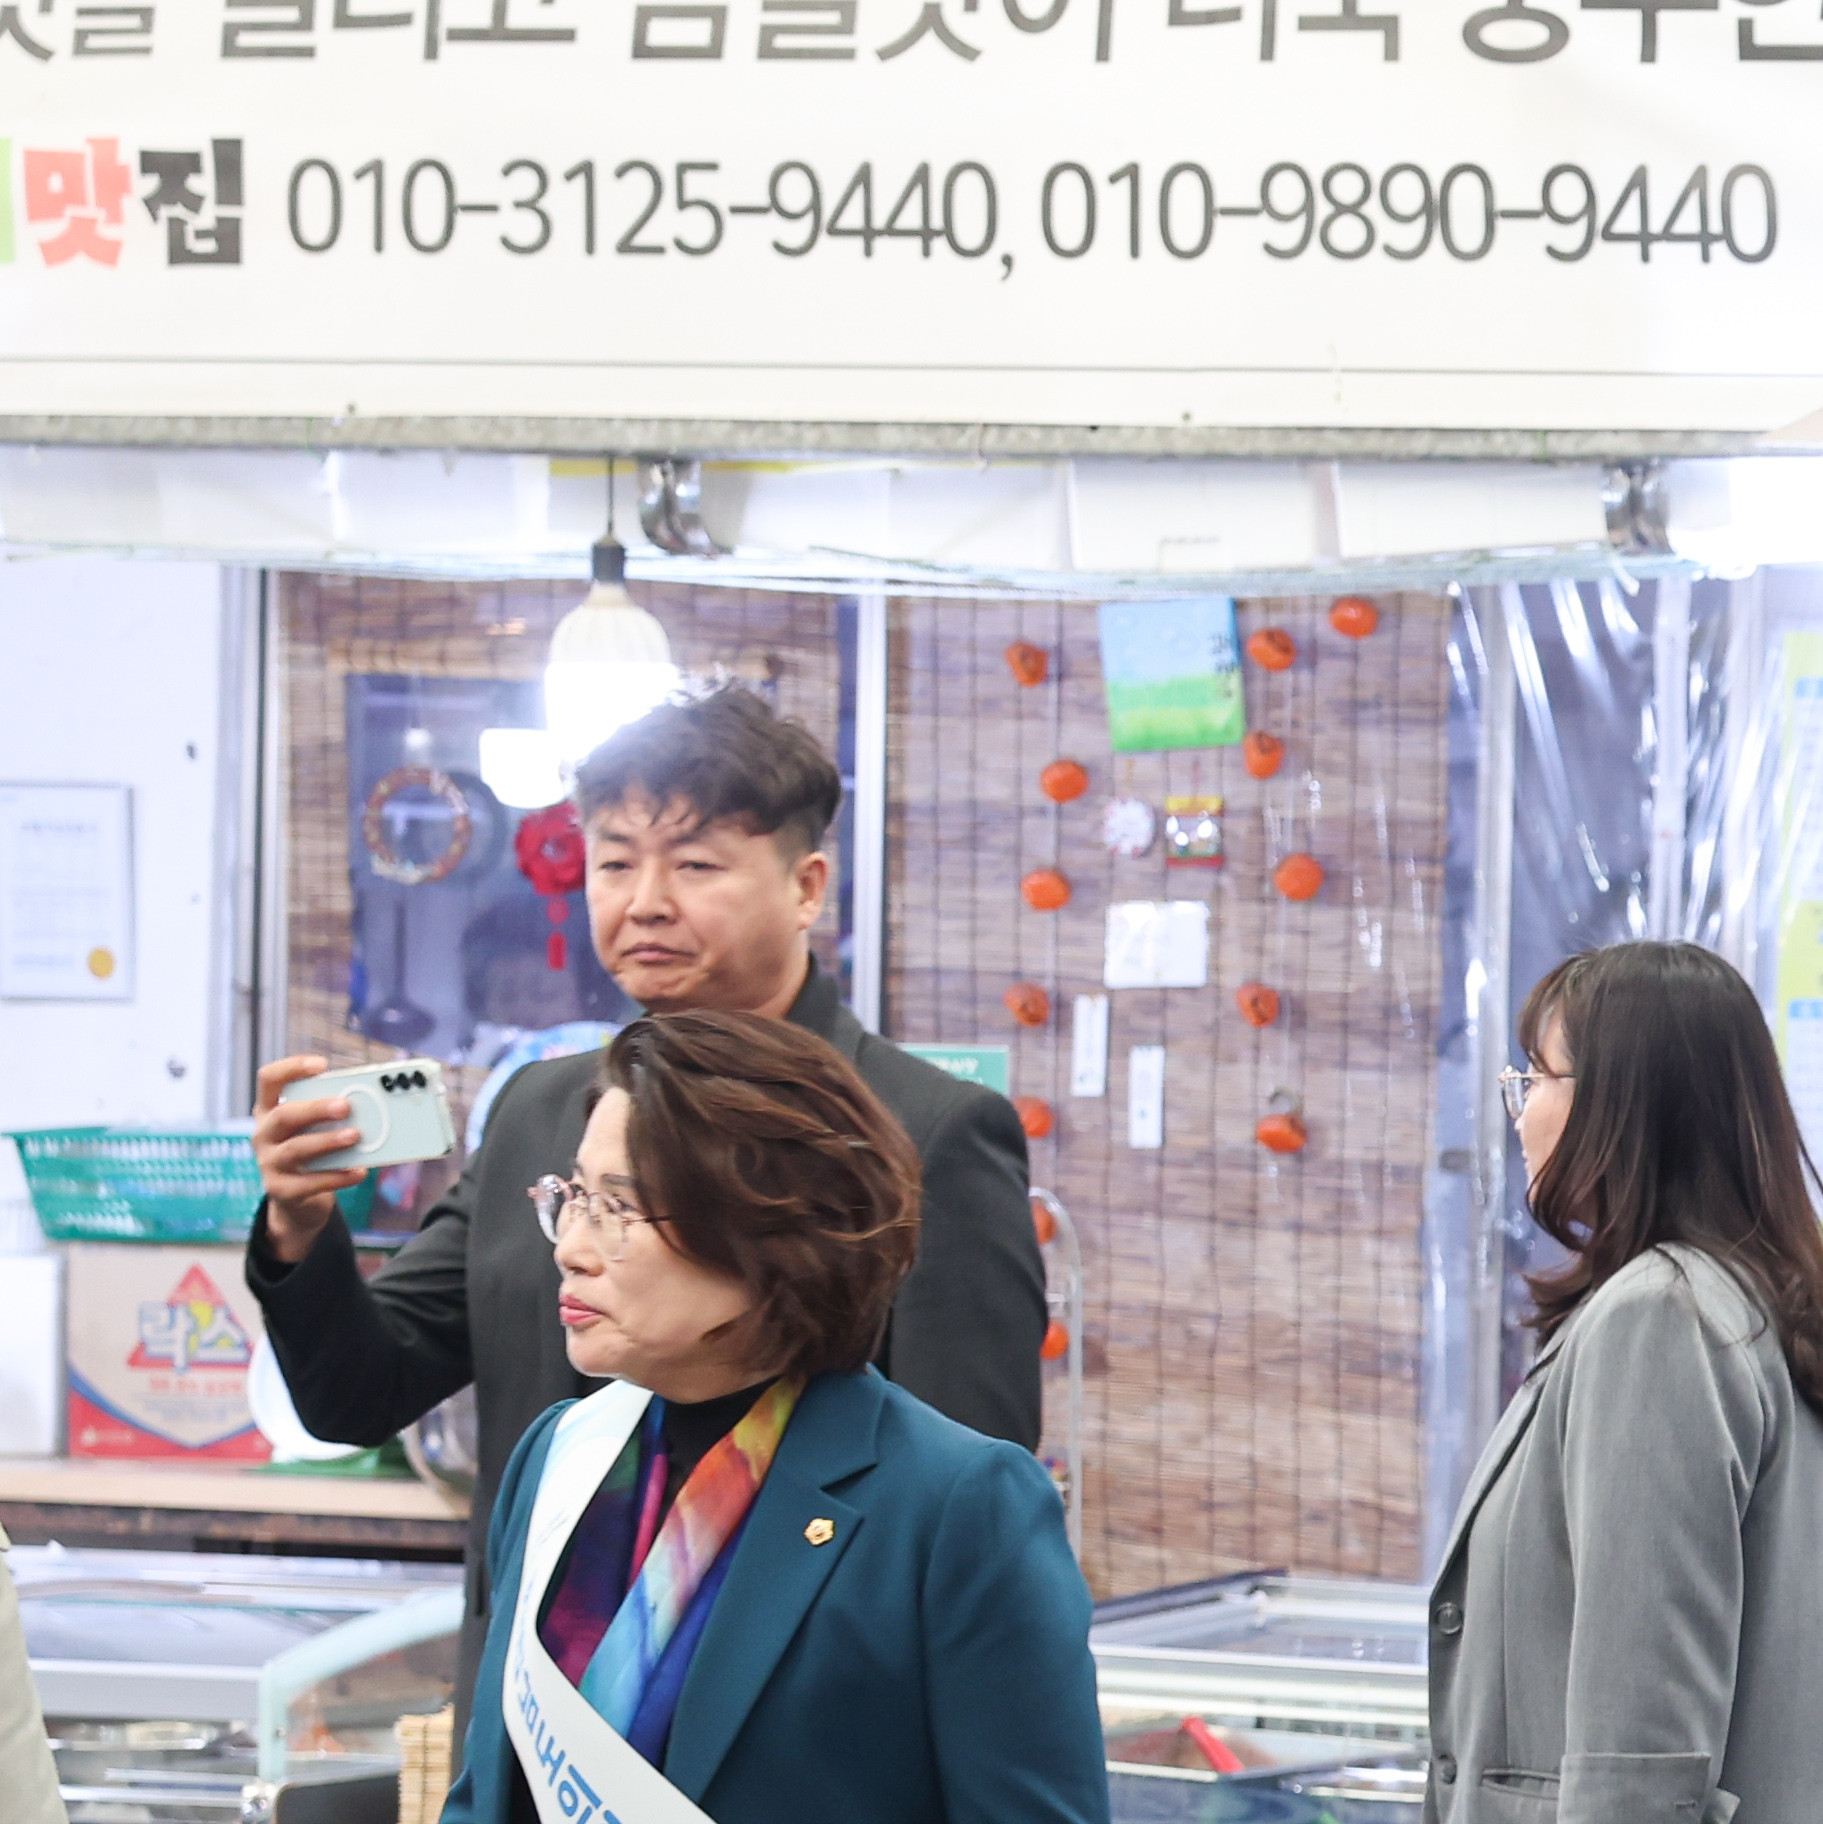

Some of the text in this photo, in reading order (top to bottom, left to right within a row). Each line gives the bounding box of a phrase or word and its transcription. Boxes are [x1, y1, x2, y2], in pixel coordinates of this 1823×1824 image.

[285, 157, 1016, 281] 010-3125-9440,
[1041, 160, 1779, 266] 010-9890-9440
[138, 1301, 251, 1373] 락스
